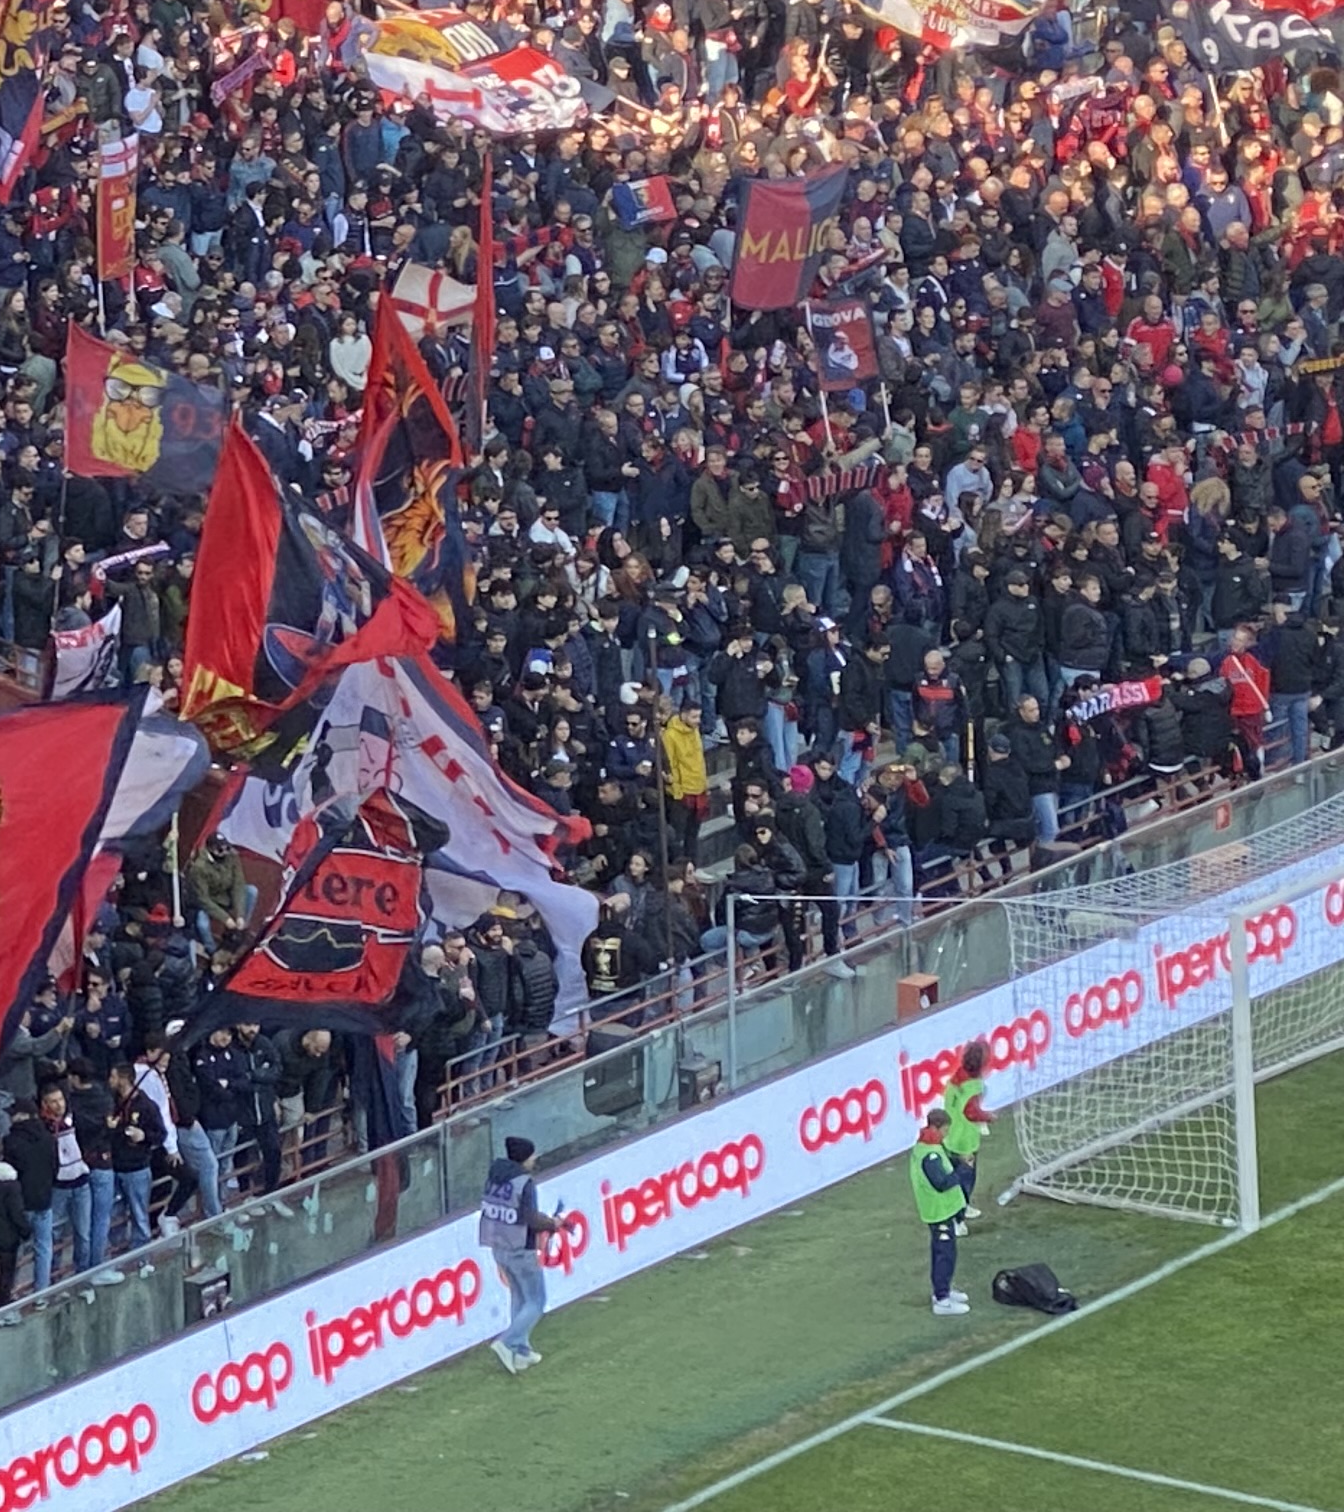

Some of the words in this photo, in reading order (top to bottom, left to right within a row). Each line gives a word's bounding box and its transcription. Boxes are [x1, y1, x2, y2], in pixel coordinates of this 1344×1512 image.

[1064, 968, 1145, 1040] coop
[798, 1077, 888, 1153] coop
[600, 1132, 766, 1252] ipercoop
[306, 1257, 483, 1383] ipercoop
[191, 1340, 296, 1425] coop
